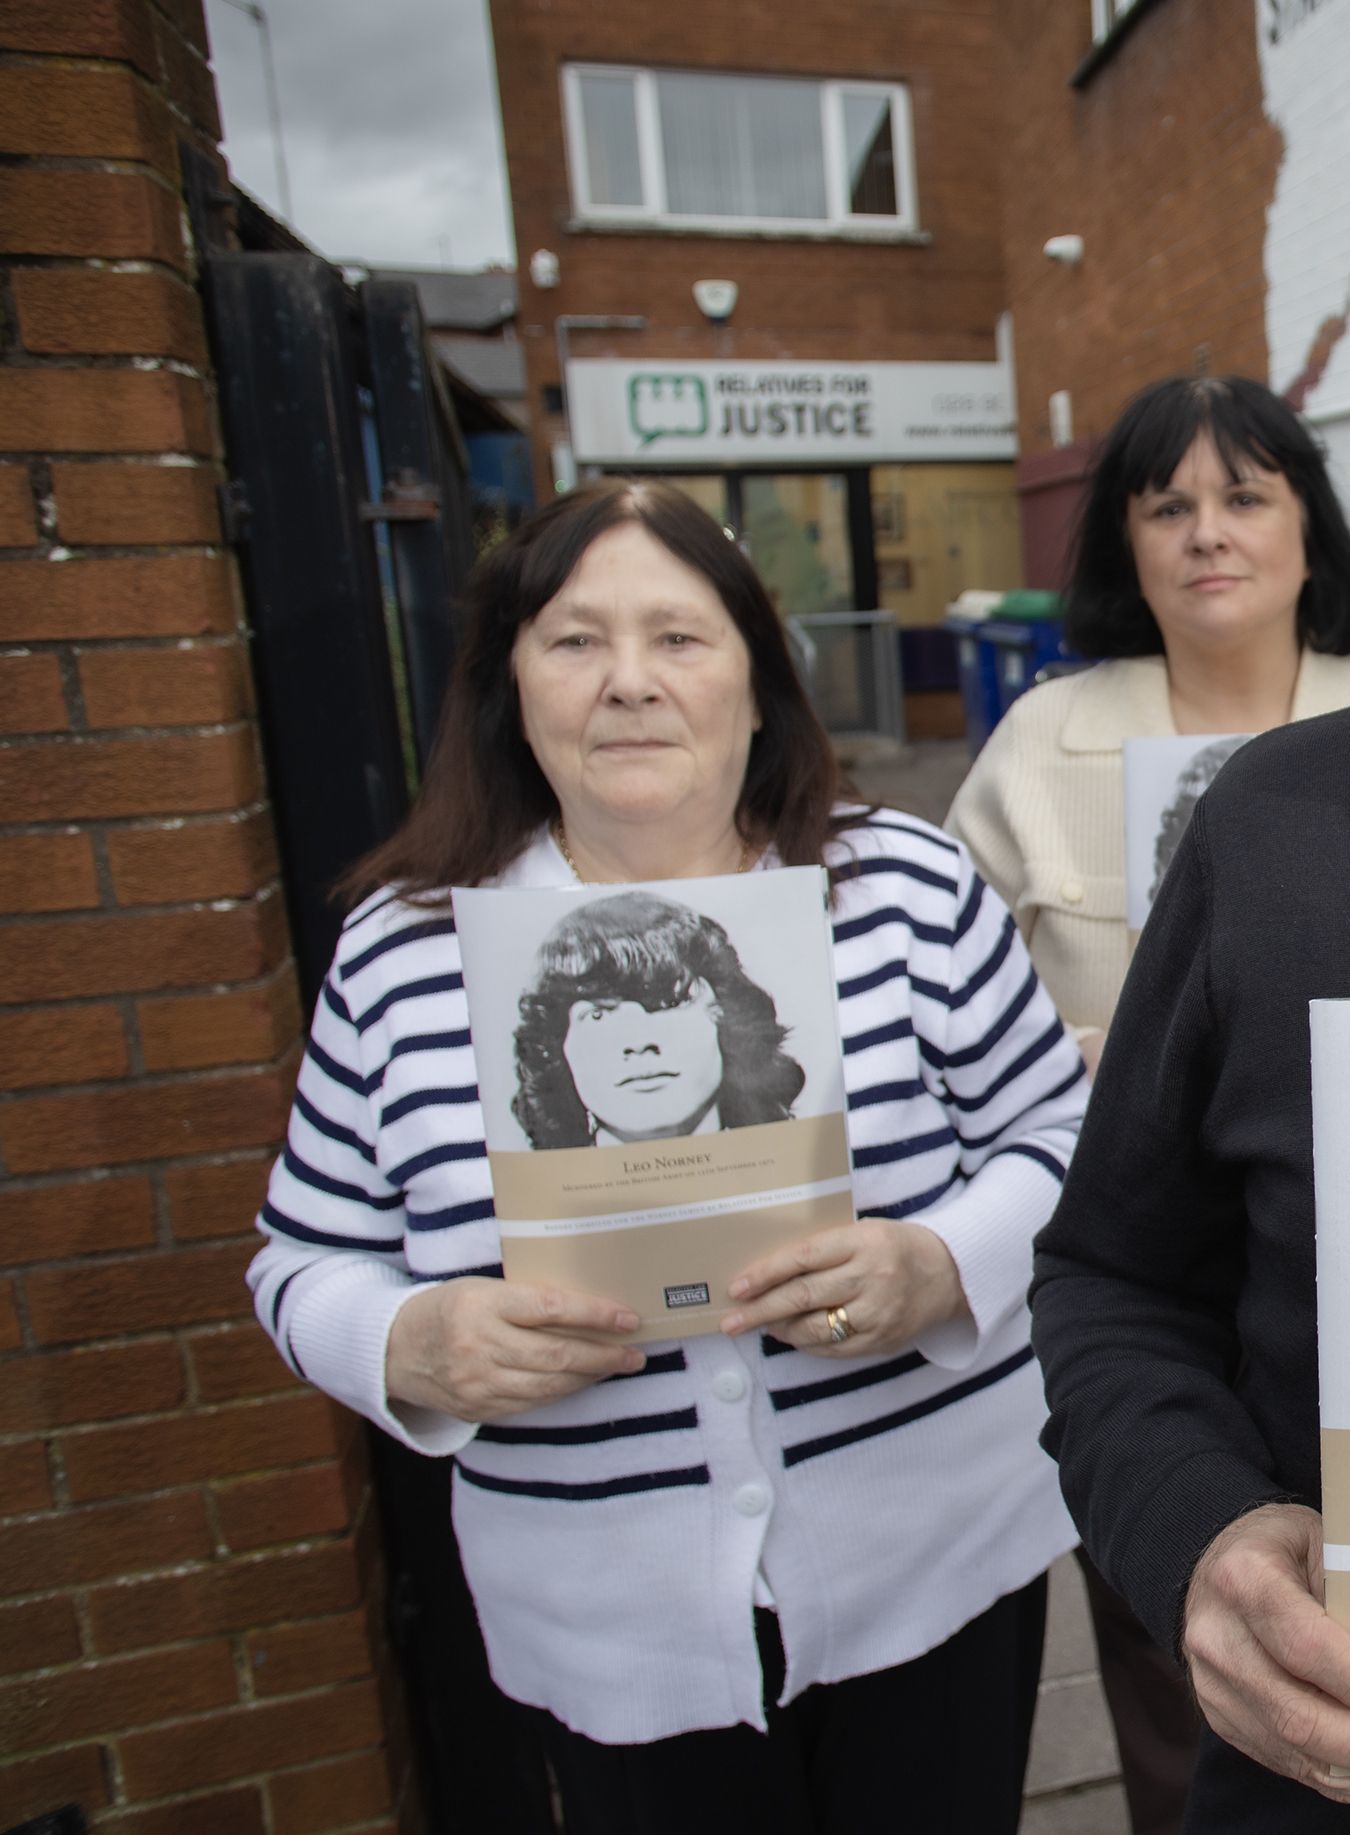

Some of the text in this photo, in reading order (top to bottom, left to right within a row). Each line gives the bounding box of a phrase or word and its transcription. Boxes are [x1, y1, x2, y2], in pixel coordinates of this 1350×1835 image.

[715, 374, 872, 395] RELATIVES FOR
[720, 401, 873, 437] JUSTICE
